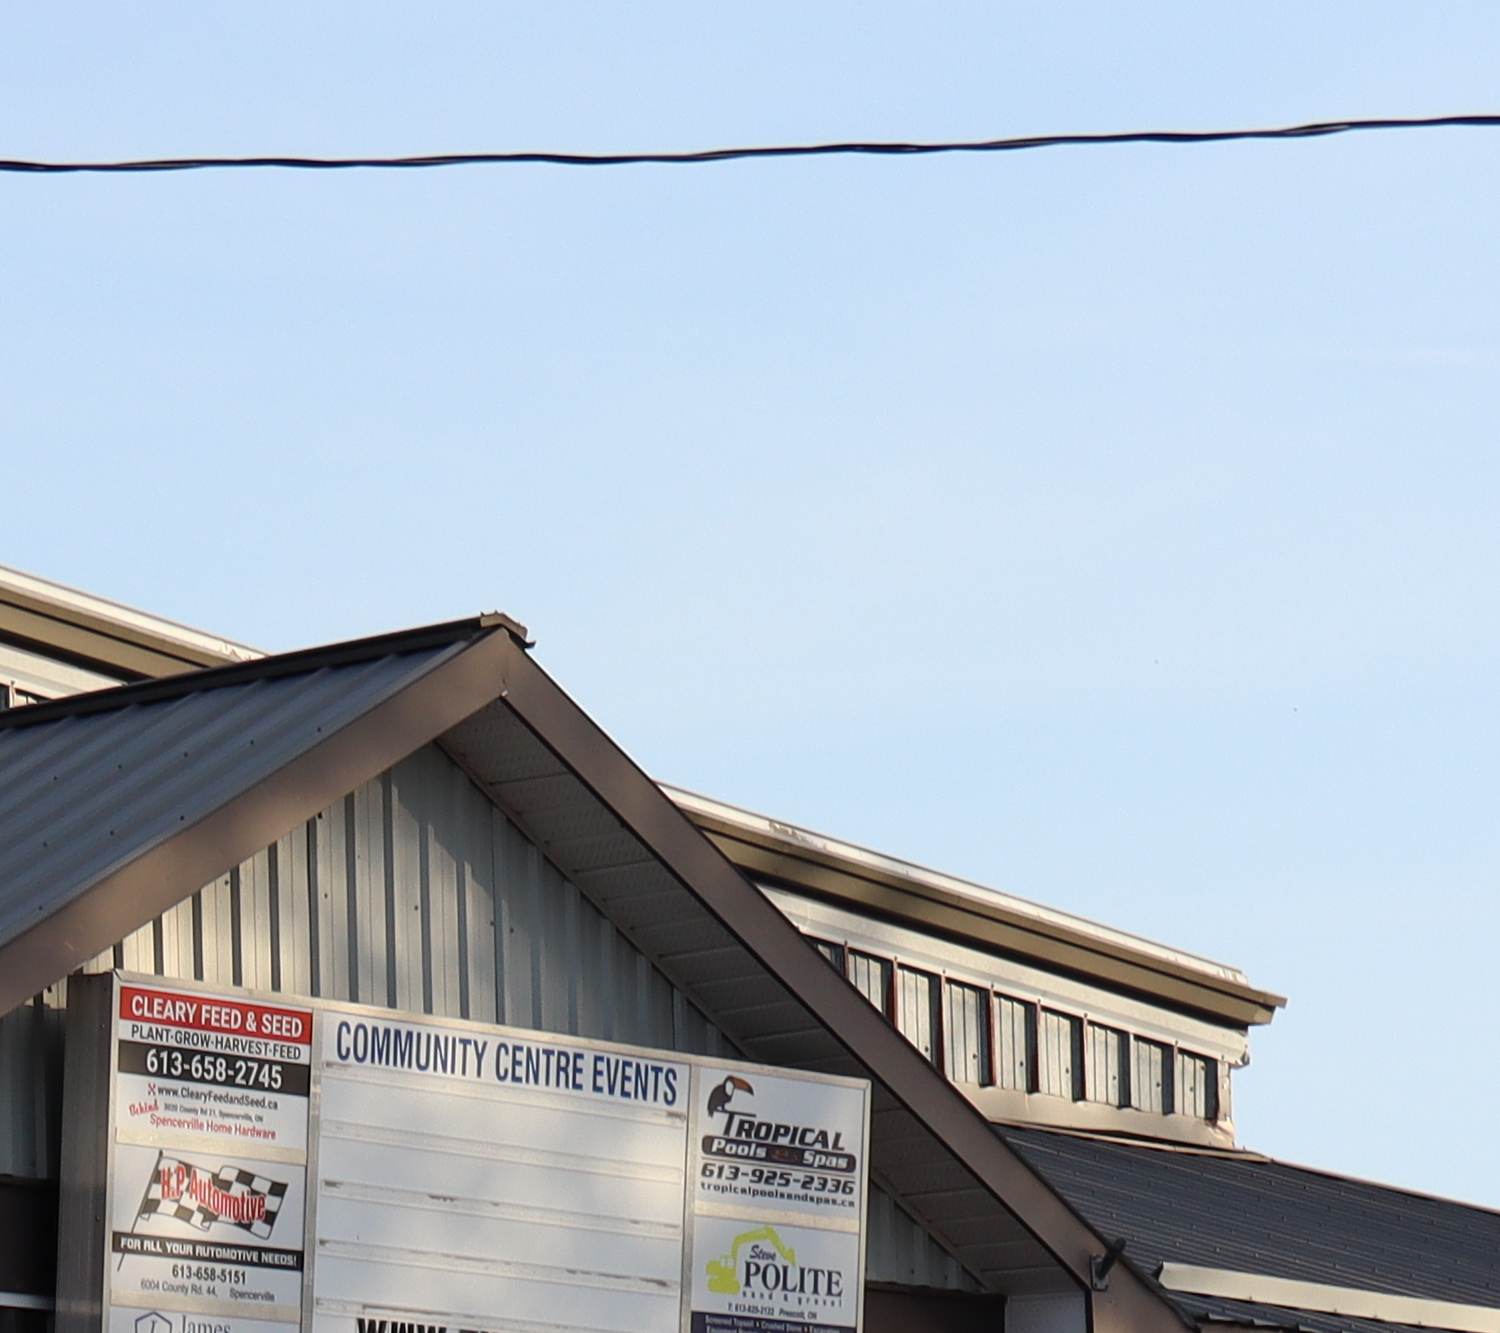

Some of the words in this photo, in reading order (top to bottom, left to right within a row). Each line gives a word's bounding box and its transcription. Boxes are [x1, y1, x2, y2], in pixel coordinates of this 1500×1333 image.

[131, 994, 197, 1024] CLEARY
[201, 1004, 242, 1030] FEED
[245, 1011, 257, 1033] &
[261, 1013, 303, 1038] SEED
[146, 1048, 283, 1090] 613-658-2745
[336, 1020, 488, 1079] COMMUNITY
[495, 1042, 585, 1091] CENTRE
[592, 1054, 678, 1107] EVENTS
[158, 1085, 279, 1111] www.ClearyFeedandSeed.ca
[150, 1113, 204, 1131] Spencerville
[206, 1120, 233, 1134] Home
[235, 1123, 277, 1140] Hardware
[715, 1109, 845, 1152] TROPICAL
[711, 1138, 768, 1159] Pools
[802, 1150, 849, 1170] Spas
[700, 1181, 855, 1208] tropicalpoolsandspas.ca
[701, 1163, 856, 1196] 613-925-2336
[189, 1169, 266, 1224] Automotive
[120, 1237, 140, 1250] FOR
[143, 1240, 163, 1253] ALL
[166, 1242, 194, 1256] YOUR
[195, 1244, 259, 1263] AUTOMOTIVE
[261, 1252, 298, 1267] NEEDS!
[749, 1244, 777, 1262] Steve
[172, 1264, 246, 1286] 613-658-5151
[744, 1260, 843, 1298] POLITE
[162, 1281, 189, 1296] County
[229, 1287, 275, 1302] Spencerville
